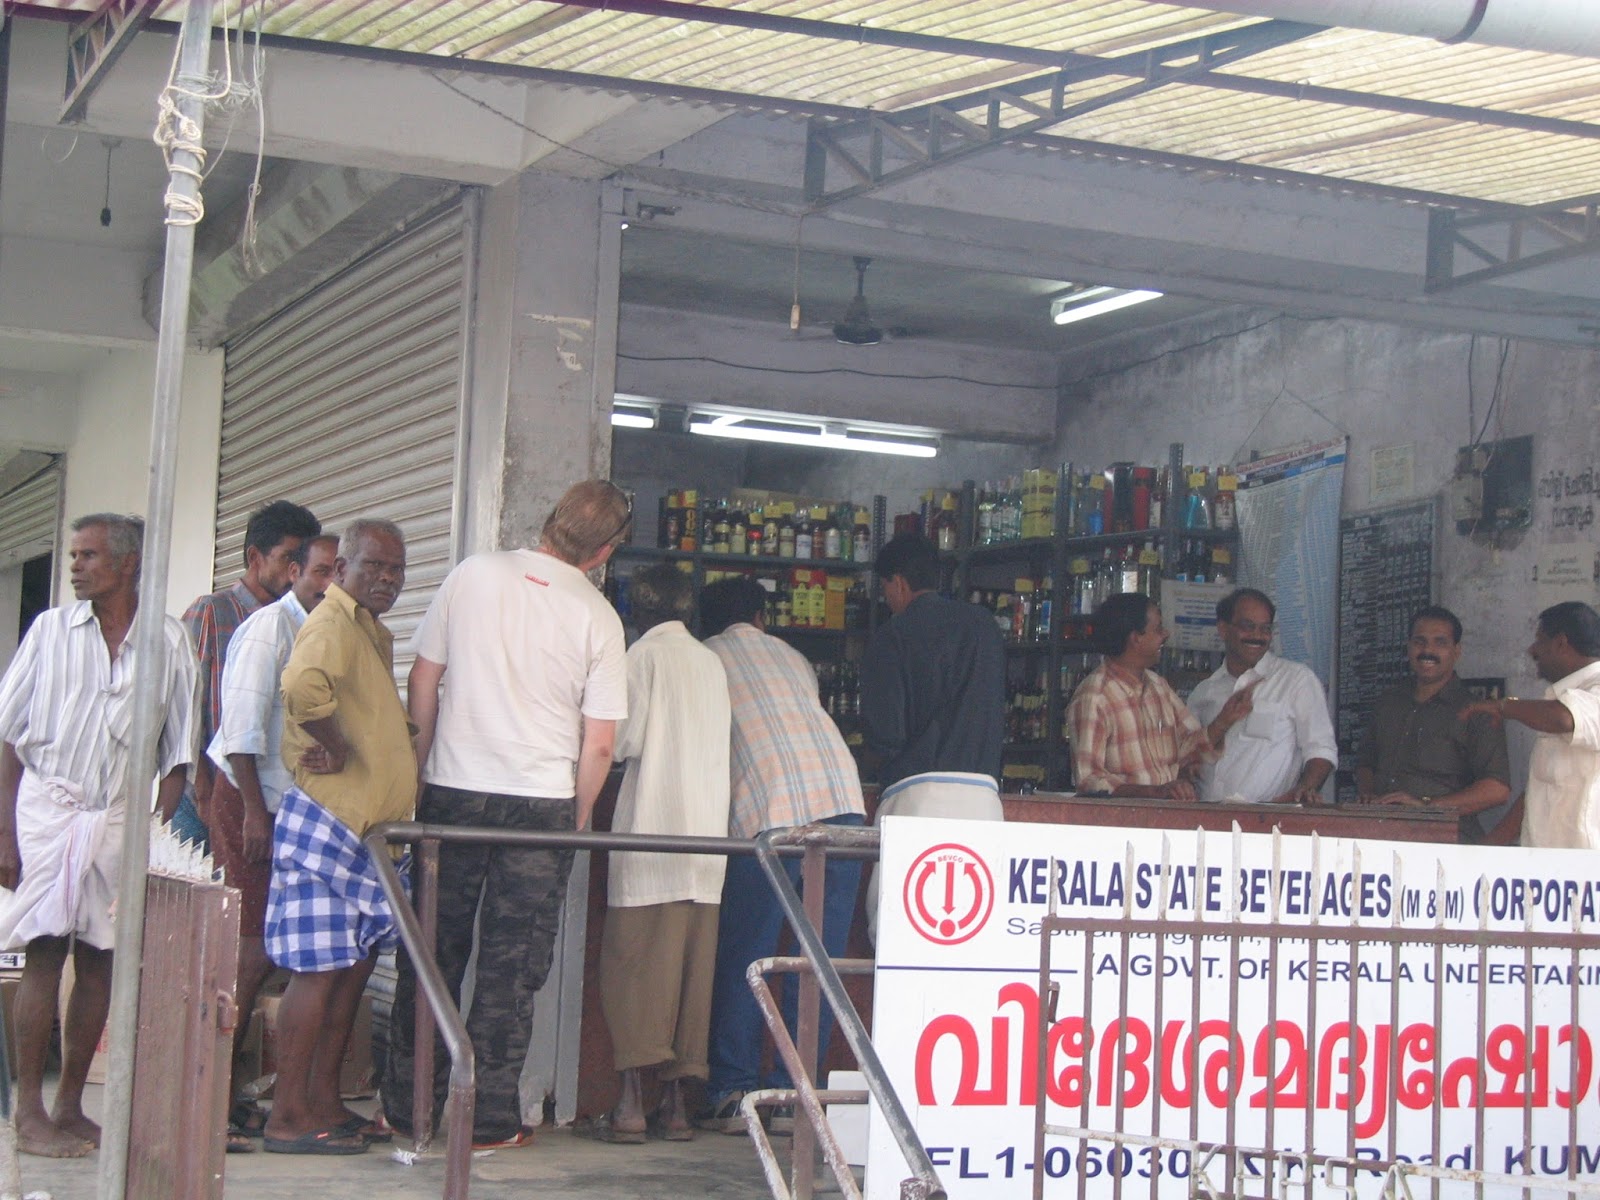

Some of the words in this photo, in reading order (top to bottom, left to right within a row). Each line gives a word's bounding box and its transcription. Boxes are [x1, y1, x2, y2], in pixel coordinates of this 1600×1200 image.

[937, 854, 964, 863] BEVCO
[1008, 858, 1124, 907] KERALA
[1401, 885, 1420, 922] (M
[1426, 889, 1437, 919] &
[1445, 886, 1464, 923] M)
[1130, 954, 1224, 978] GOVT.
[1238, 958, 1271, 980] OF
[1288, 959, 1414, 983] KERALA
